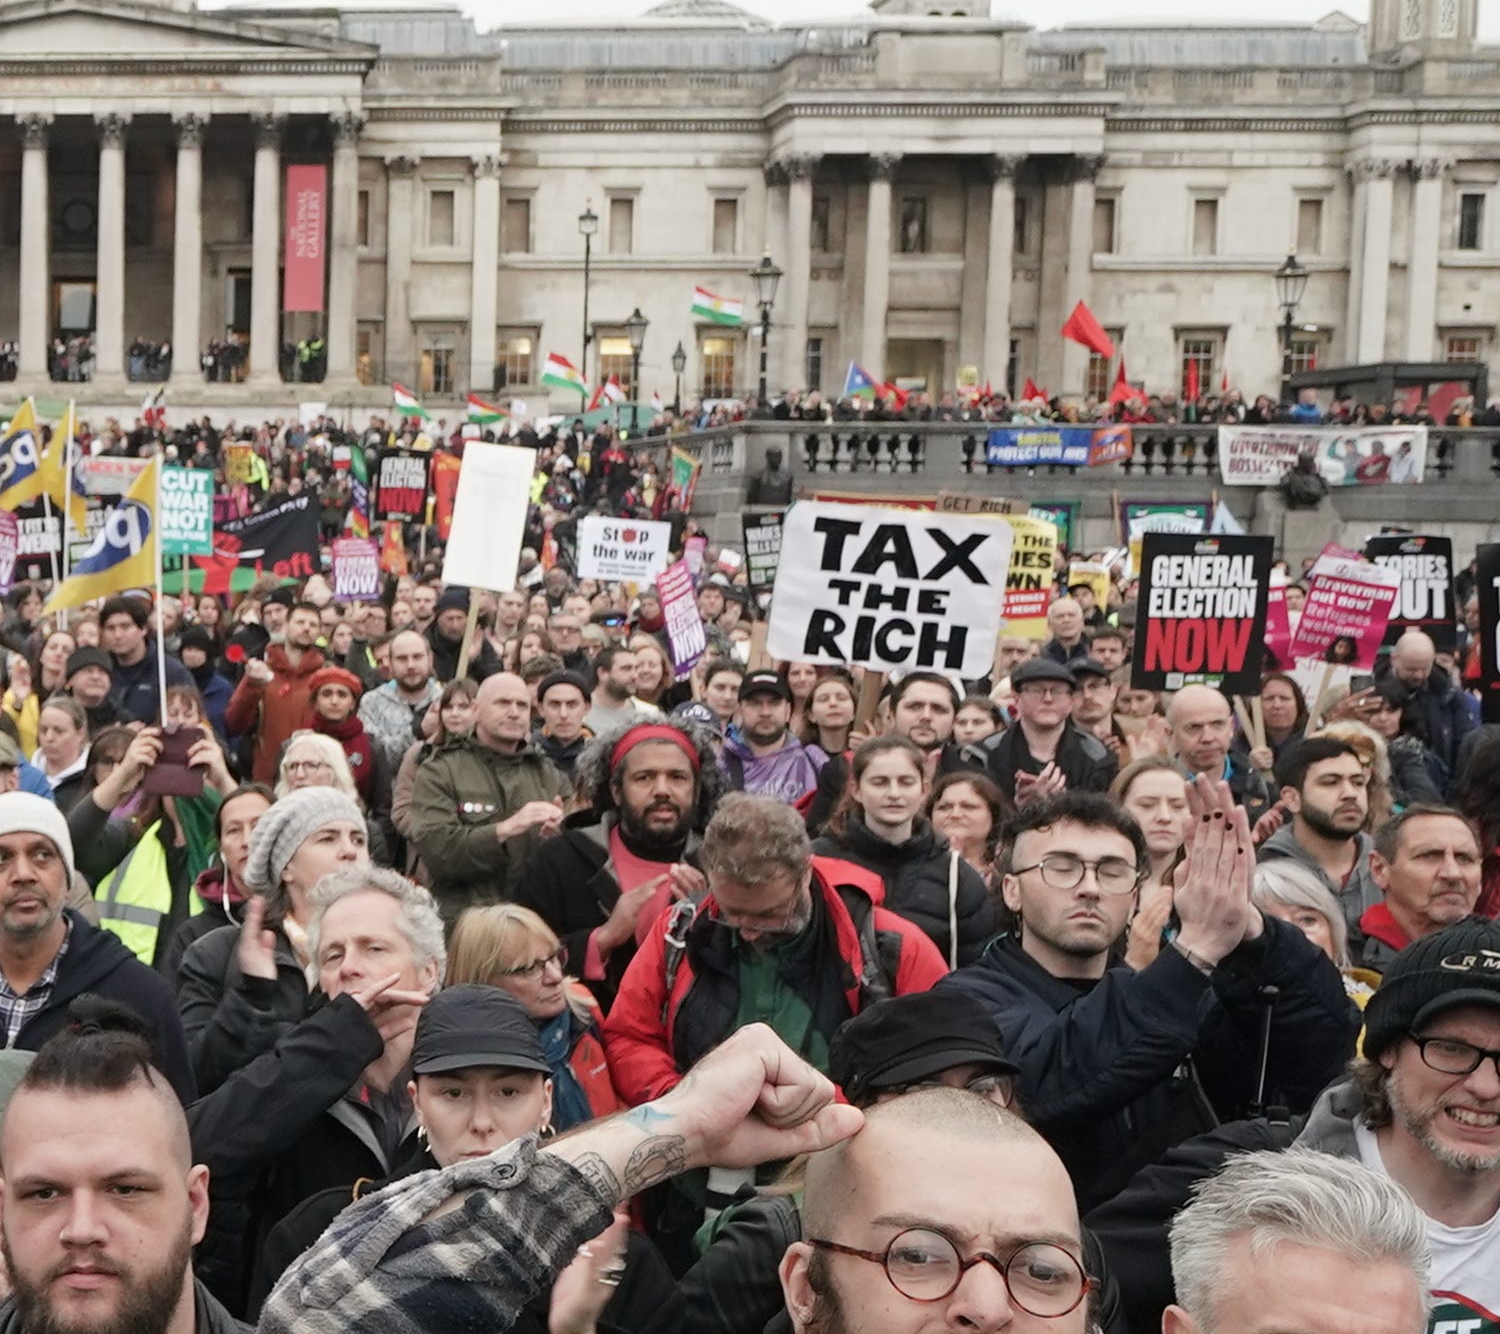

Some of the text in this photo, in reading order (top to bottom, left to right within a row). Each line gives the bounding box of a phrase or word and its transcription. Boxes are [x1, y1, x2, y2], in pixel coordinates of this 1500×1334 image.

[162, 469, 208, 492] CUT
[161, 492, 208, 512] WAR
[943, 497, 1012, 514] GET RICH
[162, 510, 207, 530] NOT
[814, 517, 990, 585] TAX
[1022, 535, 1053, 548] THE
[593, 544, 655, 563] the war
[1010, 552, 1051, 568] IES
[1151, 555, 1258, 588] GENERAL
[335, 575, 377, 595] NOW
[1314, 576, 1395, 602] Braverman
[828, 579, 950, 615] THE
[1149, 586, 1257, 618] ELECTION
[1311, 590, 1374, 611] out now!
[1305, 603, 1372, 627] Refugees
[804, 609, 968, 670] RICH
[1297, 630, 1331, 646] here
[1302, 619, 1364, 639] welcome
[1144, 618, 1254, 673] NOW
